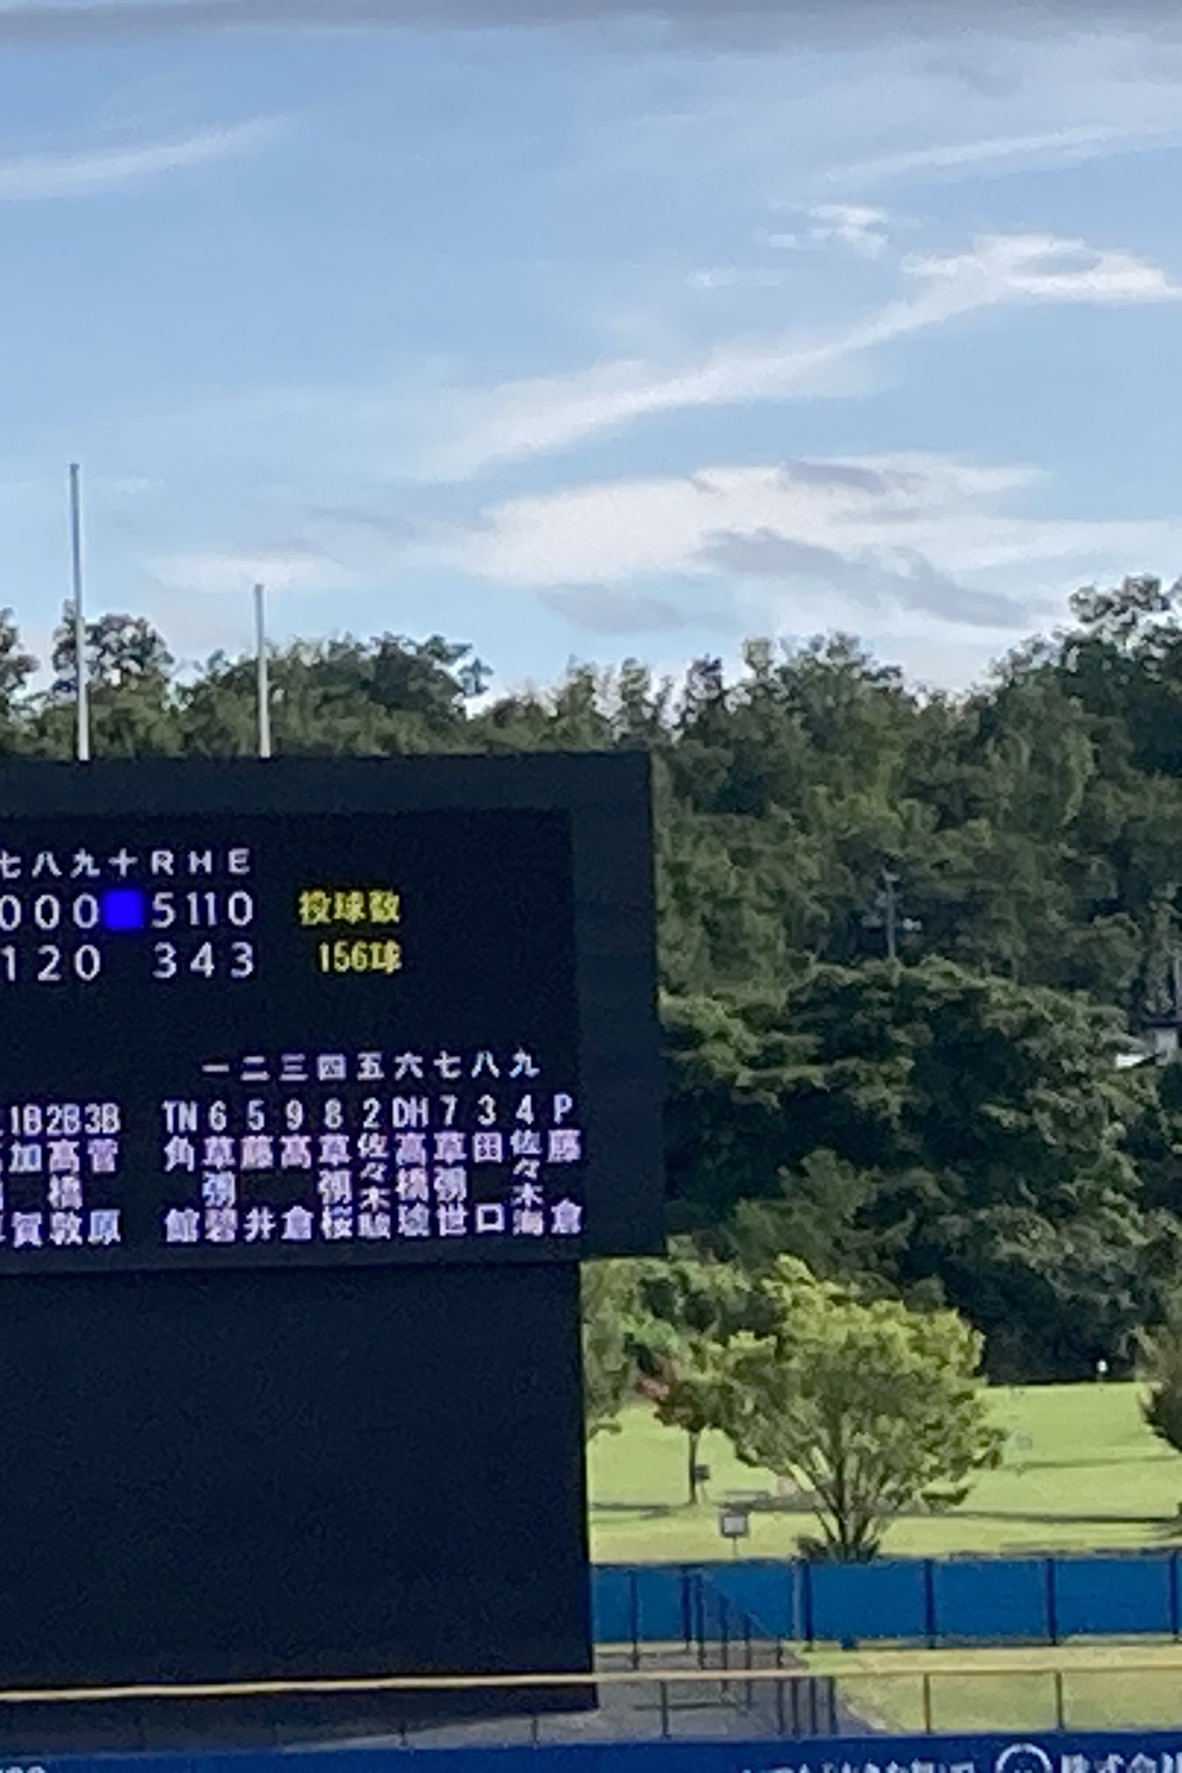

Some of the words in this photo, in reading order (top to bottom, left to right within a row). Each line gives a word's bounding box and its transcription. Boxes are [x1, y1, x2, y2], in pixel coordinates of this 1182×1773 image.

[32, 852, 62, 876] 八
[71, 849, 100, 877] 九
[109, 849, 137, 876] 十
[152, 851, 173, 875] R
[189, 851, 211, 873] H
[229, 849, 249, 873] E
[35, 895, 59, 929] 0
[73, 893, 100, 929] 0
[152, 892, 175, 928] 5
[187, 892, 216, 925] 11
[228, 891, 252, 926] 0
[2, 946, 15, 980] 1
[38, 945, 60, 980] 2
[75, 945, 100, 980] 0
[154, 942, 176, 978] 3
[190, 942, 214, 977] 4
[232, 942, 253, 977] 3
[242, 1056, 269, 1080] 二
[280, 1054, 308, 1081] 三
[317, 1054, 346, 1080] 四
[357, 1052, 384, 1080] 五
[395, 1052, 423, 1080] 六
[434, 1051, 461, 1078] 七
[472, 1051, 499, 1077] 八
[509, 1049, 539, 1078] 九
[11, 1104, 42, 1136] 1B
[47, 1104, 82, 1136] 2B
[85, 1103, 120, 1134] 3B
[163, 1101, 197, 1133] TN
[209, 1100, 226, 1132] 6
[248, 1100, 264, 1131] 5
[286, 1100, 303, 1130] 9
[324, 1099, 343, 1129] 8
[363, 1098, 381, 1129] 2
[392, 1097, 429, 1128] DH
[441, 1095, 457, 1126] 7
[478, 1095, 496, 1126] 3
[516, 1095, 534, 1124] 4
[554, 1093, 572, 1124] P
[472, 1132, 505, 1233] 田口
